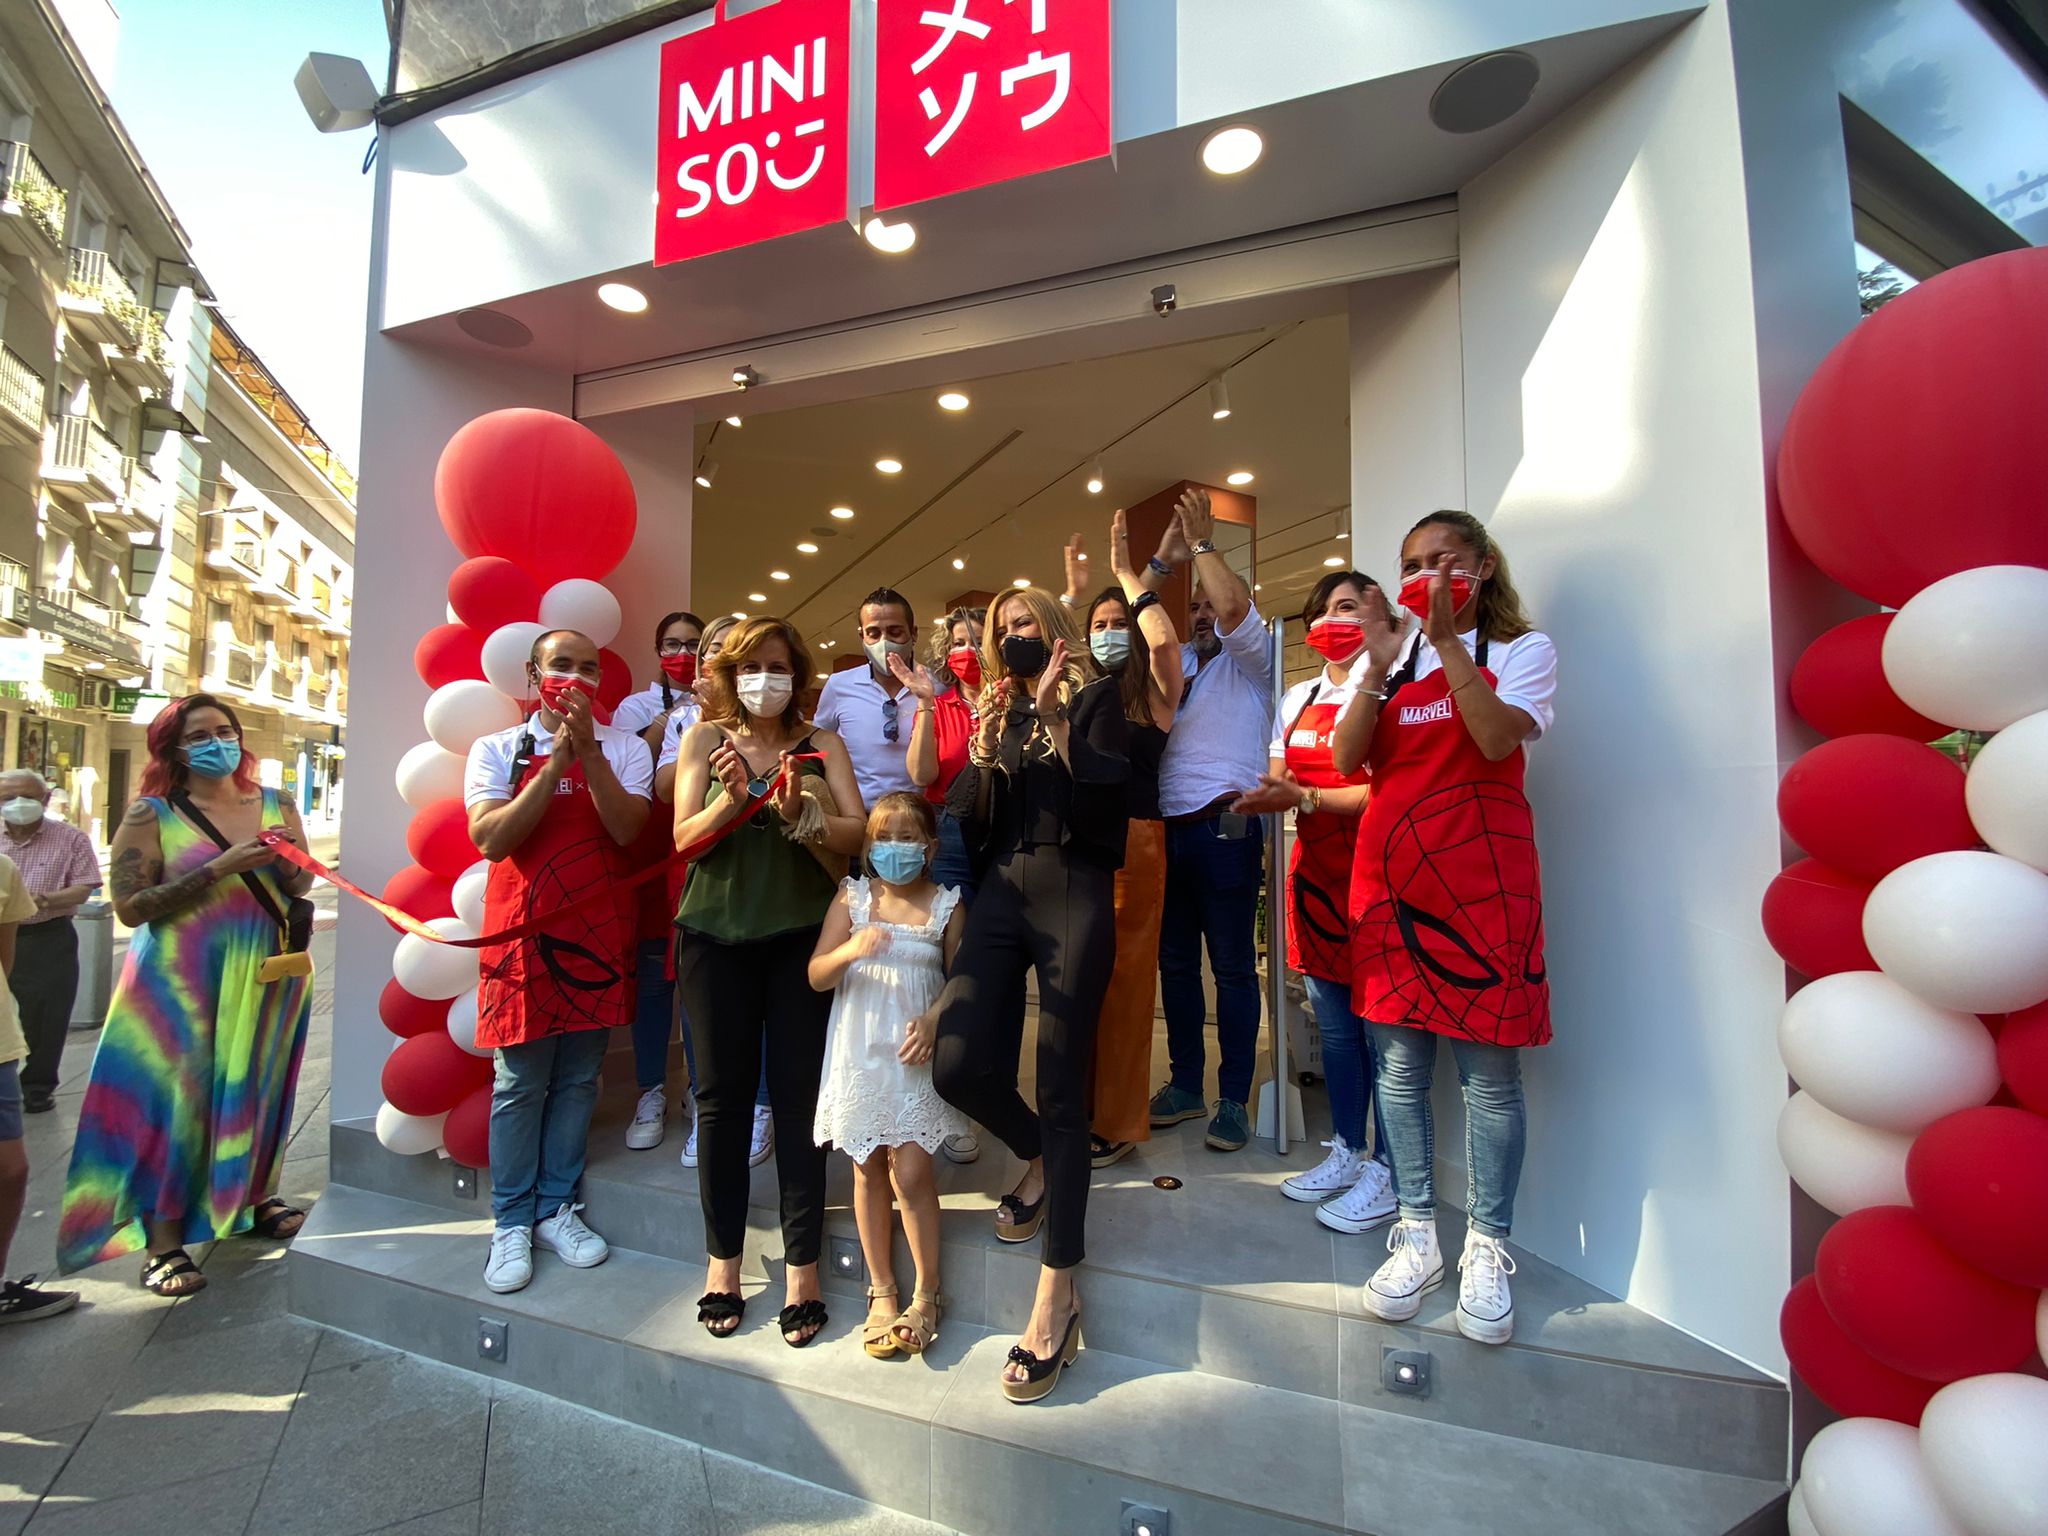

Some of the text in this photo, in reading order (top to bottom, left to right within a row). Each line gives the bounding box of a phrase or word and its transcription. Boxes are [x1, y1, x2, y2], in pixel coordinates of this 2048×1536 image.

[678, 36, 826, 139] MINI
[917, 50, 1071, 158] ソウ
[1402, 701, 1450, 722] MARVEL
